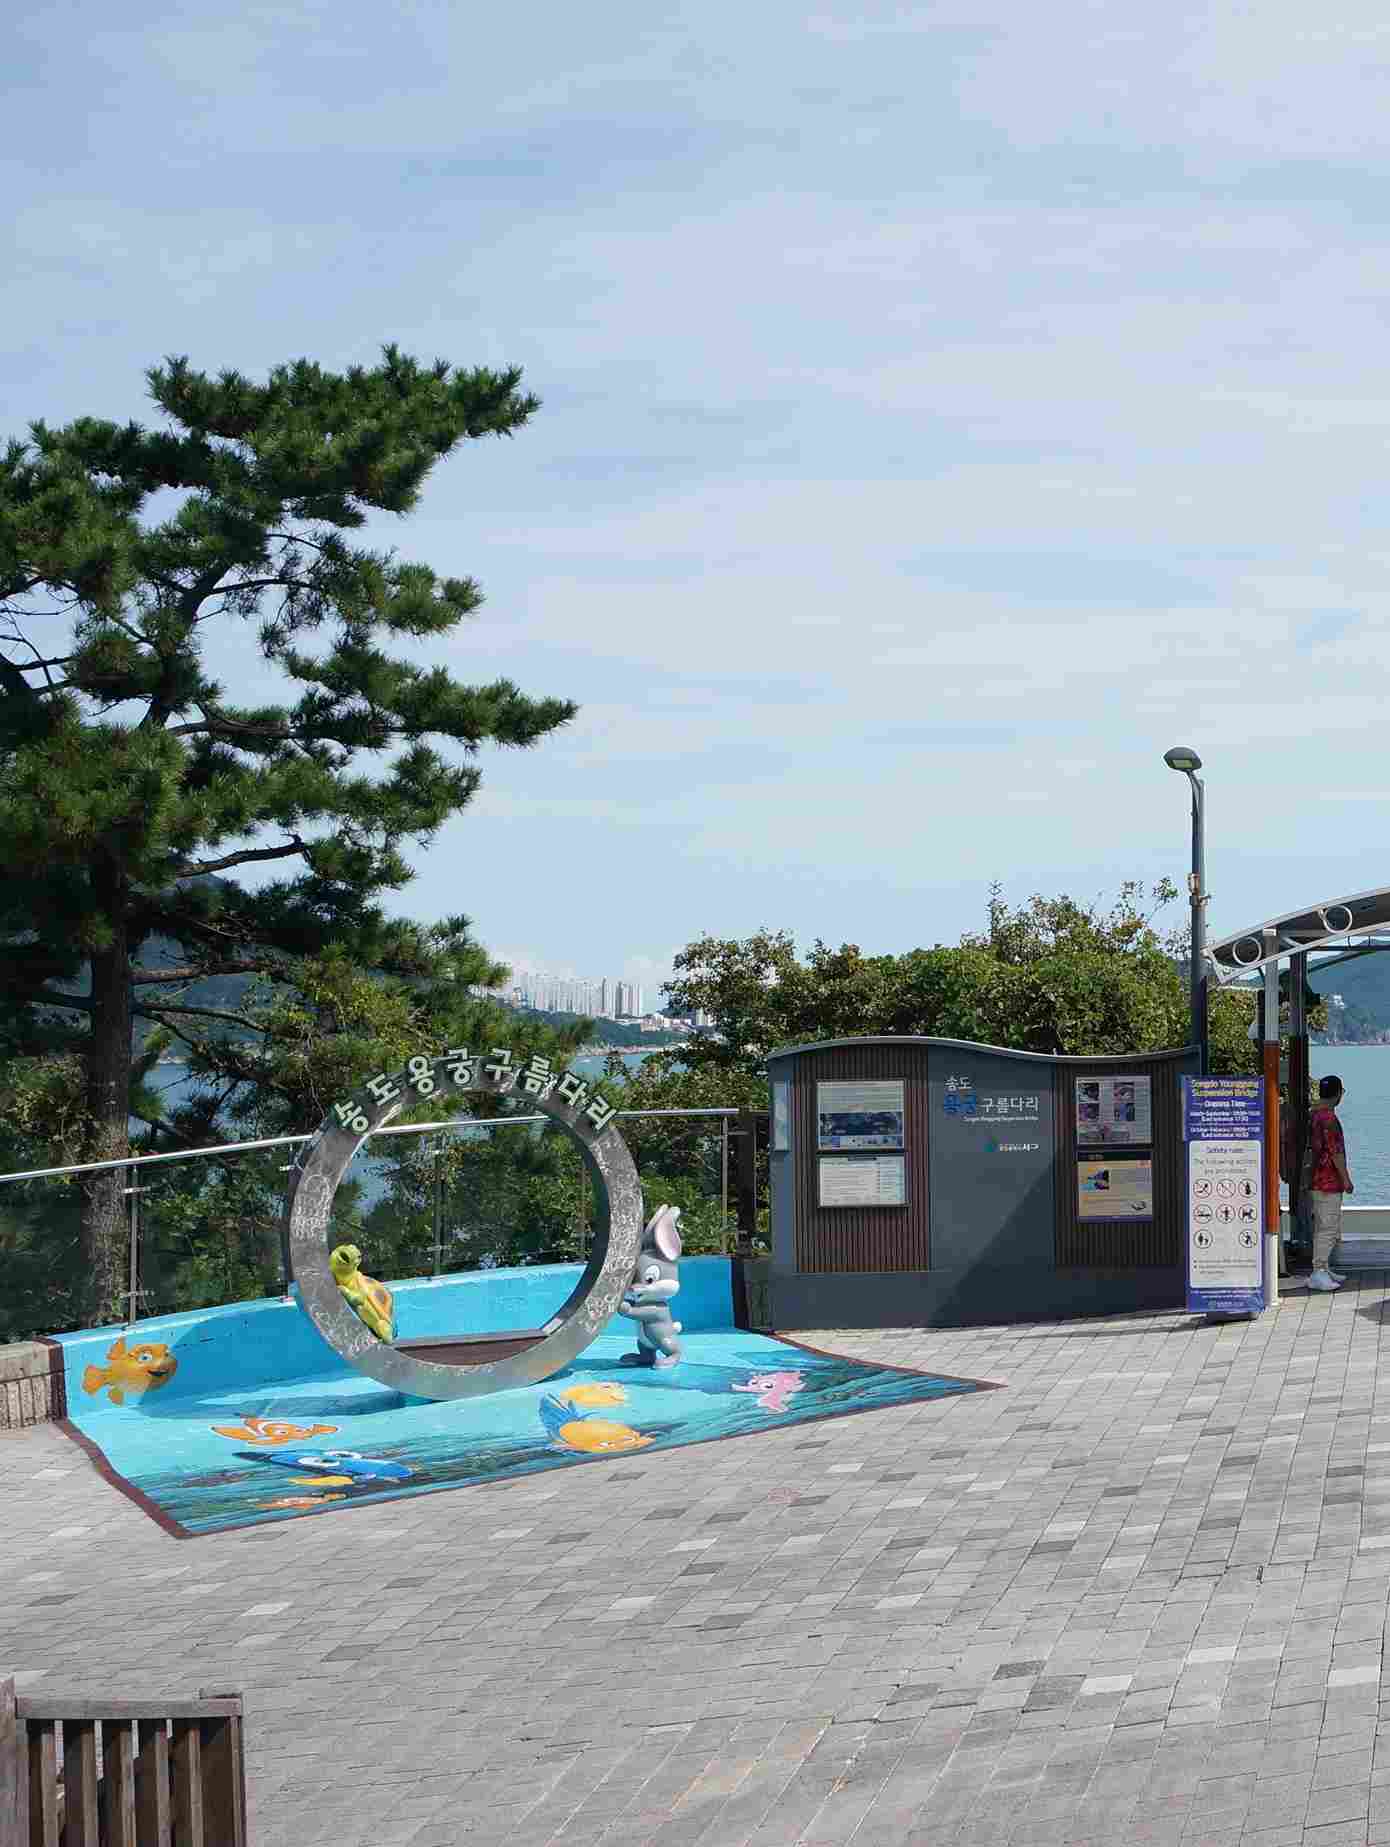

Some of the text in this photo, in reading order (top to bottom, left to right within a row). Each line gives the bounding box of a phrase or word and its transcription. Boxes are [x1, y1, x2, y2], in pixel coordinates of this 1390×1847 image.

[335, 1047, 617, 1132] 송도용궁구름다리
[945, 1076, 972, 1091] 송도
[981, 1096, 1039, 1113] 구름다리
